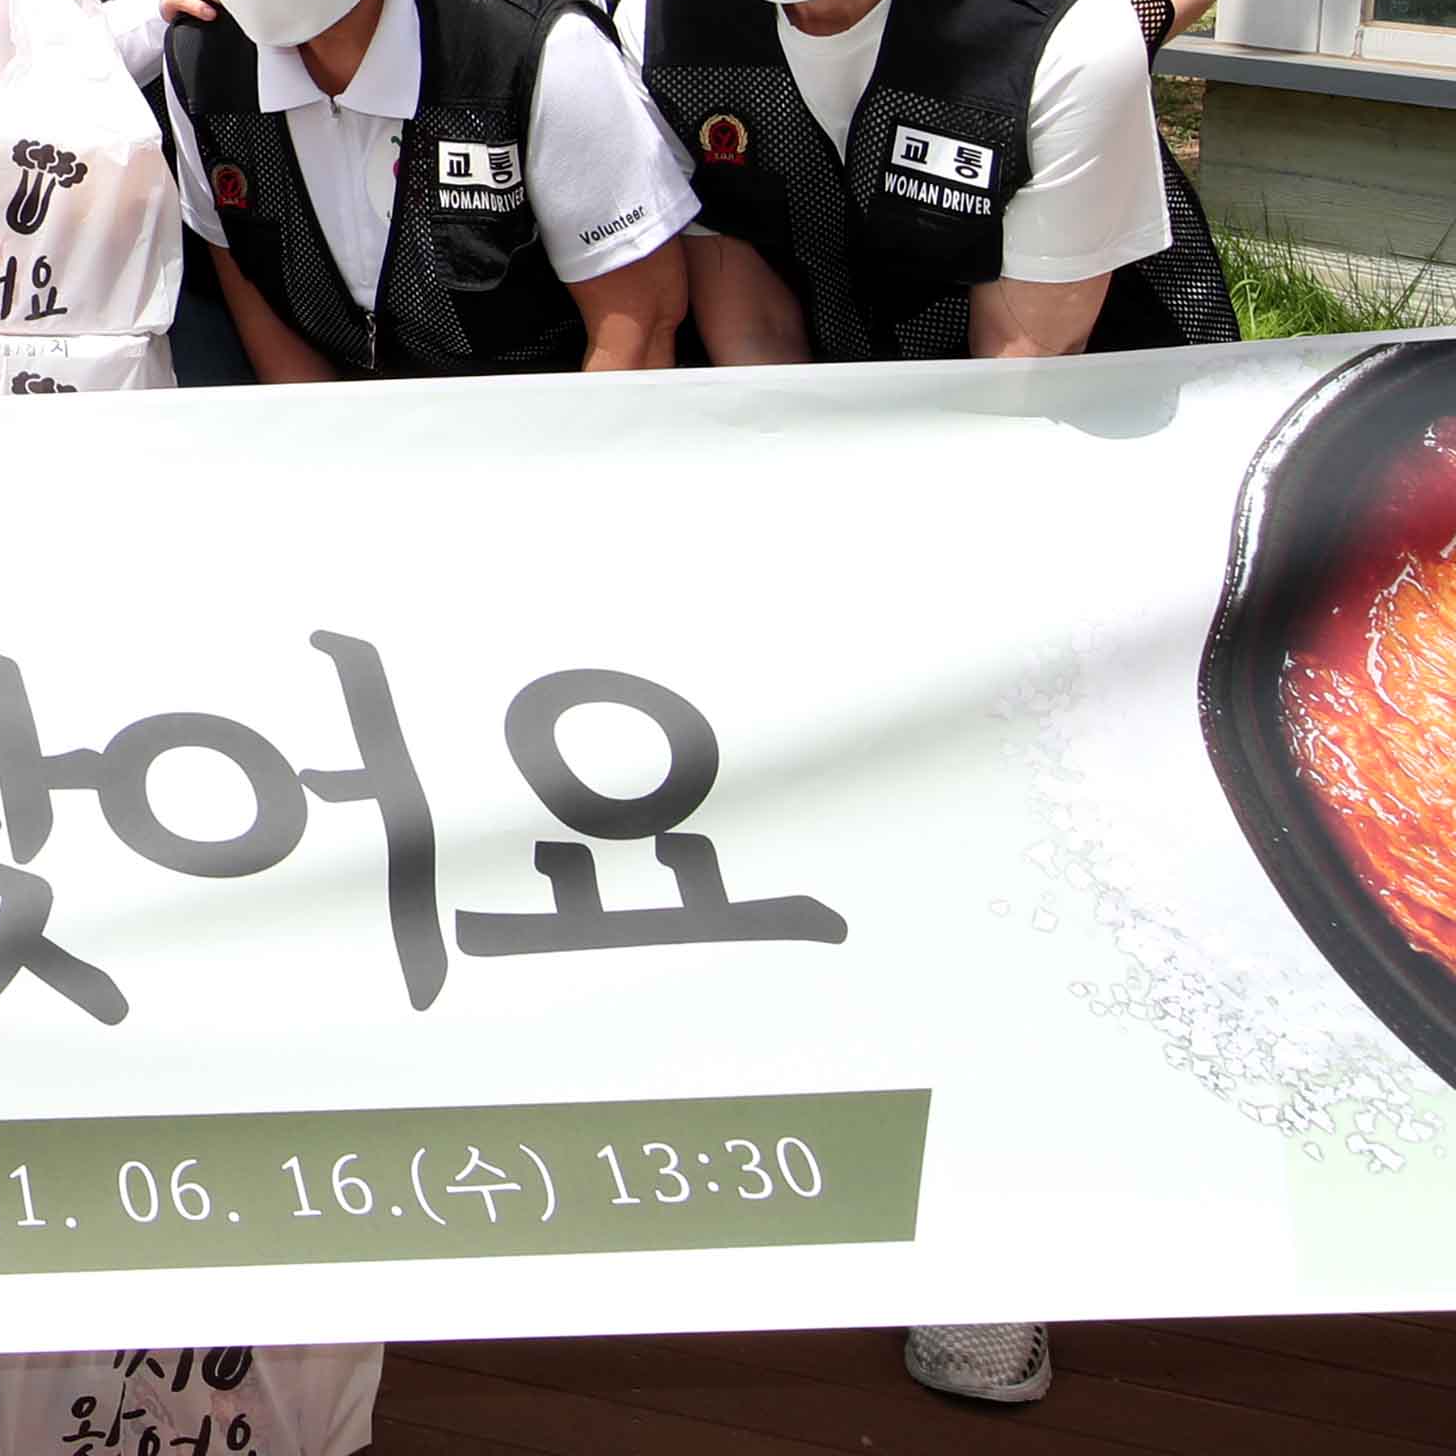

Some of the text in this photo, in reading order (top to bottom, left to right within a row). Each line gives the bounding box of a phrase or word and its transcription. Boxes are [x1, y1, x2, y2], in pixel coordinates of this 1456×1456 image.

[900, 136, 983, 179] 교통
[439, 187, 525, 213] WOMAN DRIVER
[884, 171, 992, 215] WOMAN DRIVER
[579, 204, 647, 245] Volunteer
[116, 1156, 241, 1226] 06.
[596, 1136, 823, 1206] 13:30
